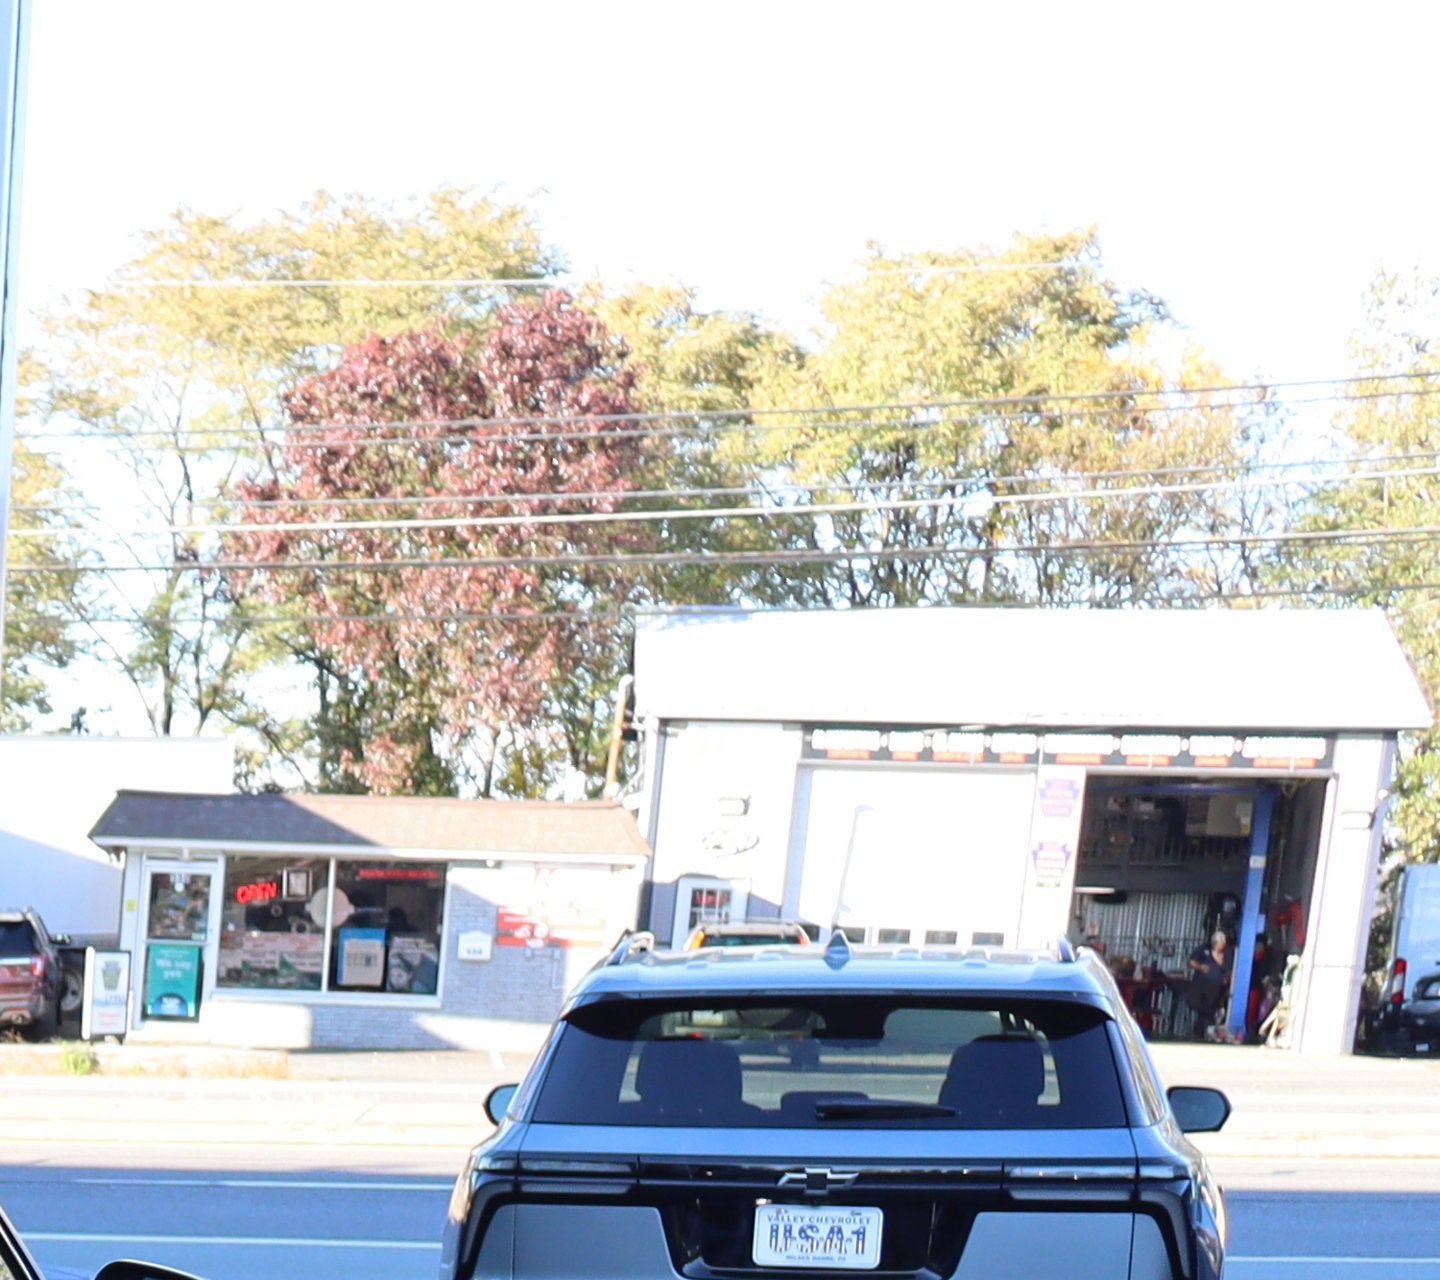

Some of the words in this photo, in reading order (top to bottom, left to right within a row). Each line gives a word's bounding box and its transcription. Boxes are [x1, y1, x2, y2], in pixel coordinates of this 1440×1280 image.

[236, 882, 278, 904] OPEN
[767, 1214, 807, 1223] VALLEY
[808, 1216, 871, 1225] CHEVROLET
